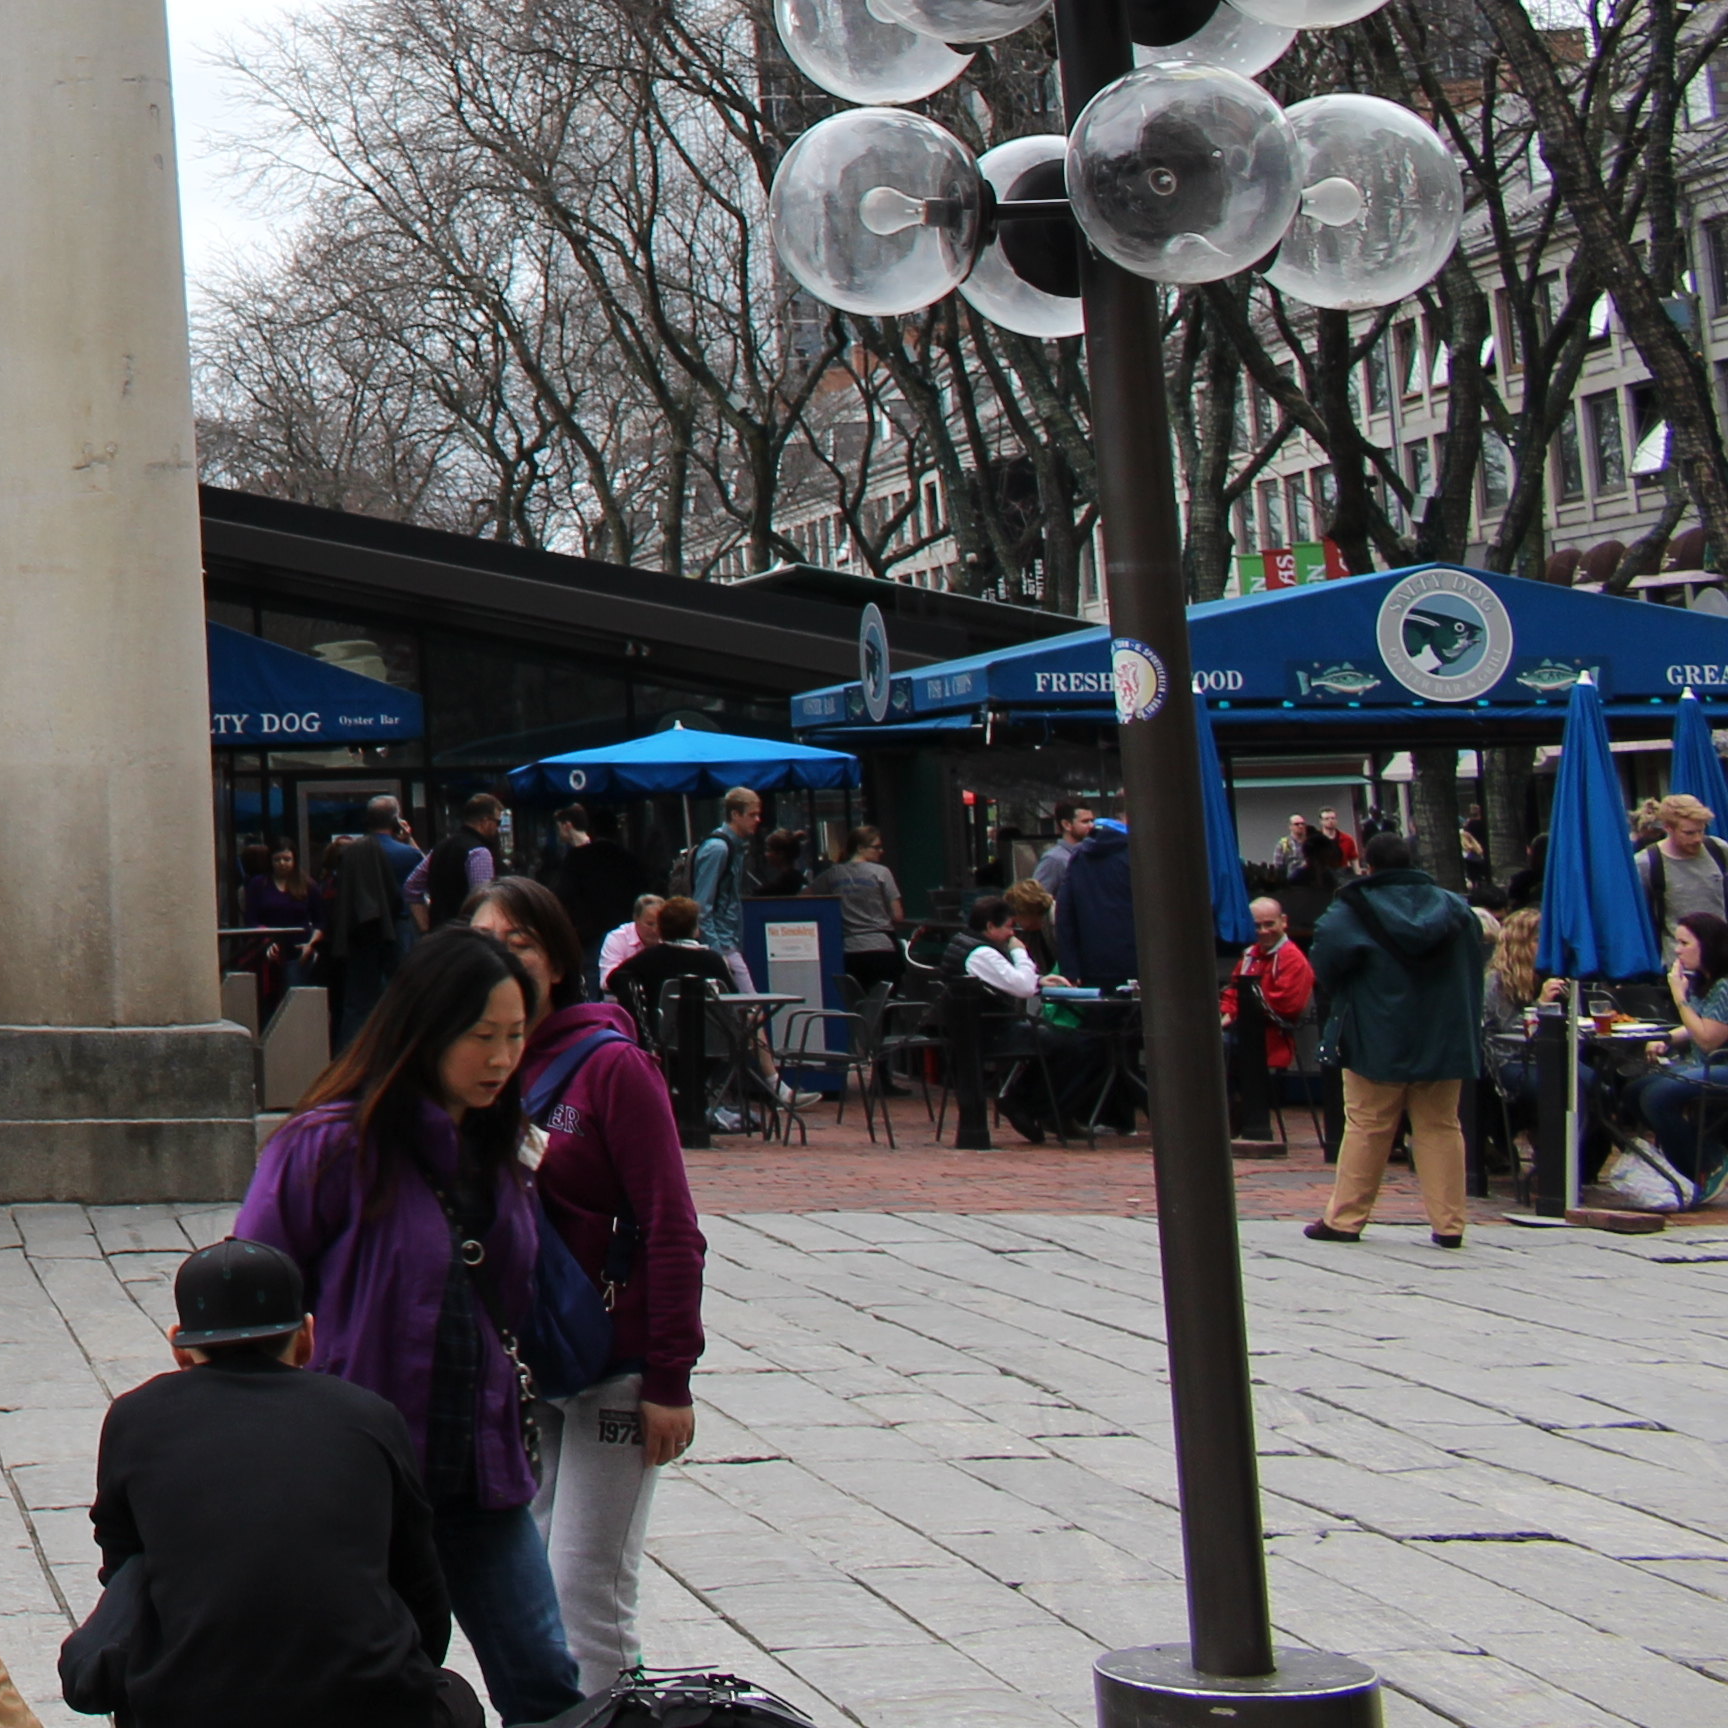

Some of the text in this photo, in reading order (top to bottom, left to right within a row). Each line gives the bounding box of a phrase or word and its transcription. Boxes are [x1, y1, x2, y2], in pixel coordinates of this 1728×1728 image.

[1388, 574, 1492, 611] SALTY DOG
[1388, 647, 1430, 690] OYSTER
[1435, 683, 1462, 694] BAR
[1035, 672, 1115, 693] FRESH
[210, 712, 321, 734] TY DOG
[339, 714, 400, 726] Oyster Bar
[767, 927, 816, 937] No Smoking
[598, 1421, 645, 1447] 1972
